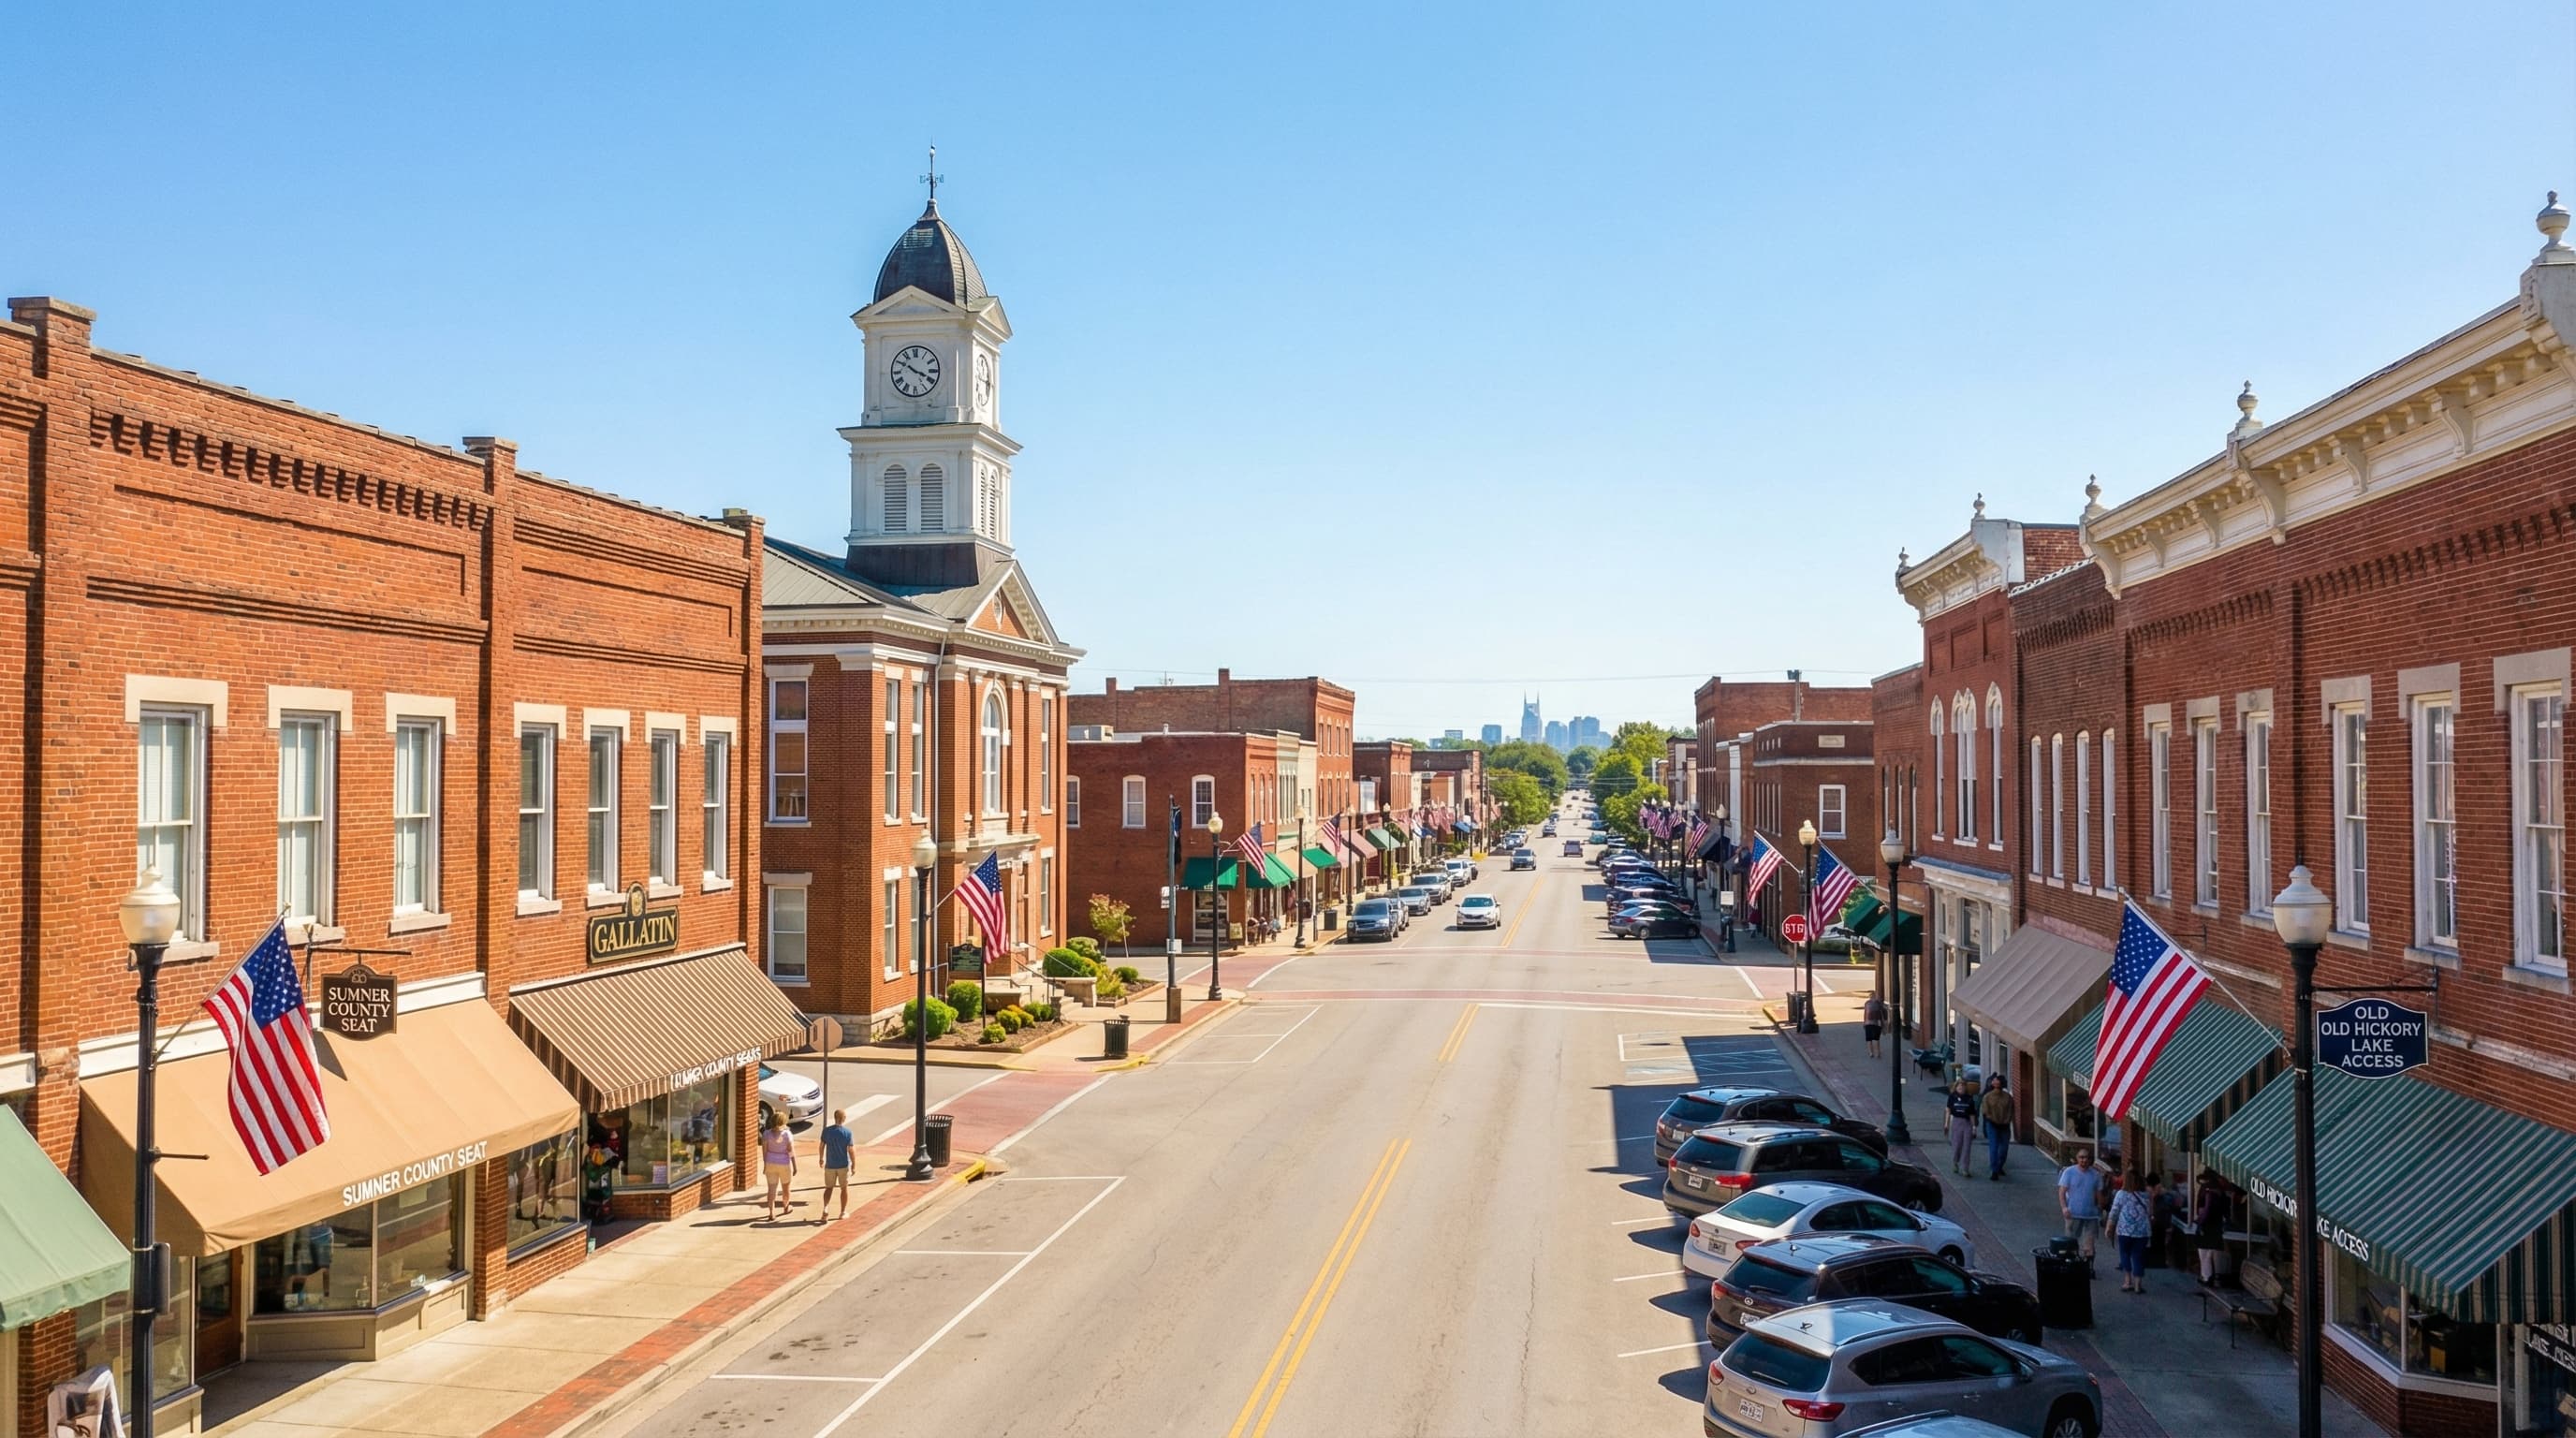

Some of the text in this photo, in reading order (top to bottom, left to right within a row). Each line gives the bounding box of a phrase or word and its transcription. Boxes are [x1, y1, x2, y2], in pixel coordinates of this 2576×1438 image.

[594, 915, 676, 953] GALLATIN
[329, 987, 391, 1002] SUMNER
[328, 1002, 390, 1018] COUNTY
[2354, 1006, 2390, 1020] OLD
[341, 1018, 378, 1033] SEAT
[2320, 1021, 2422, 1036] OLD HICKORY
[2351, 1038, 2393, 1052] LAKE
[2341, 1054, 2405, 1067] ACCESS
[343, 1140, 487, 1207] SUMNER COUNTY SEAT
